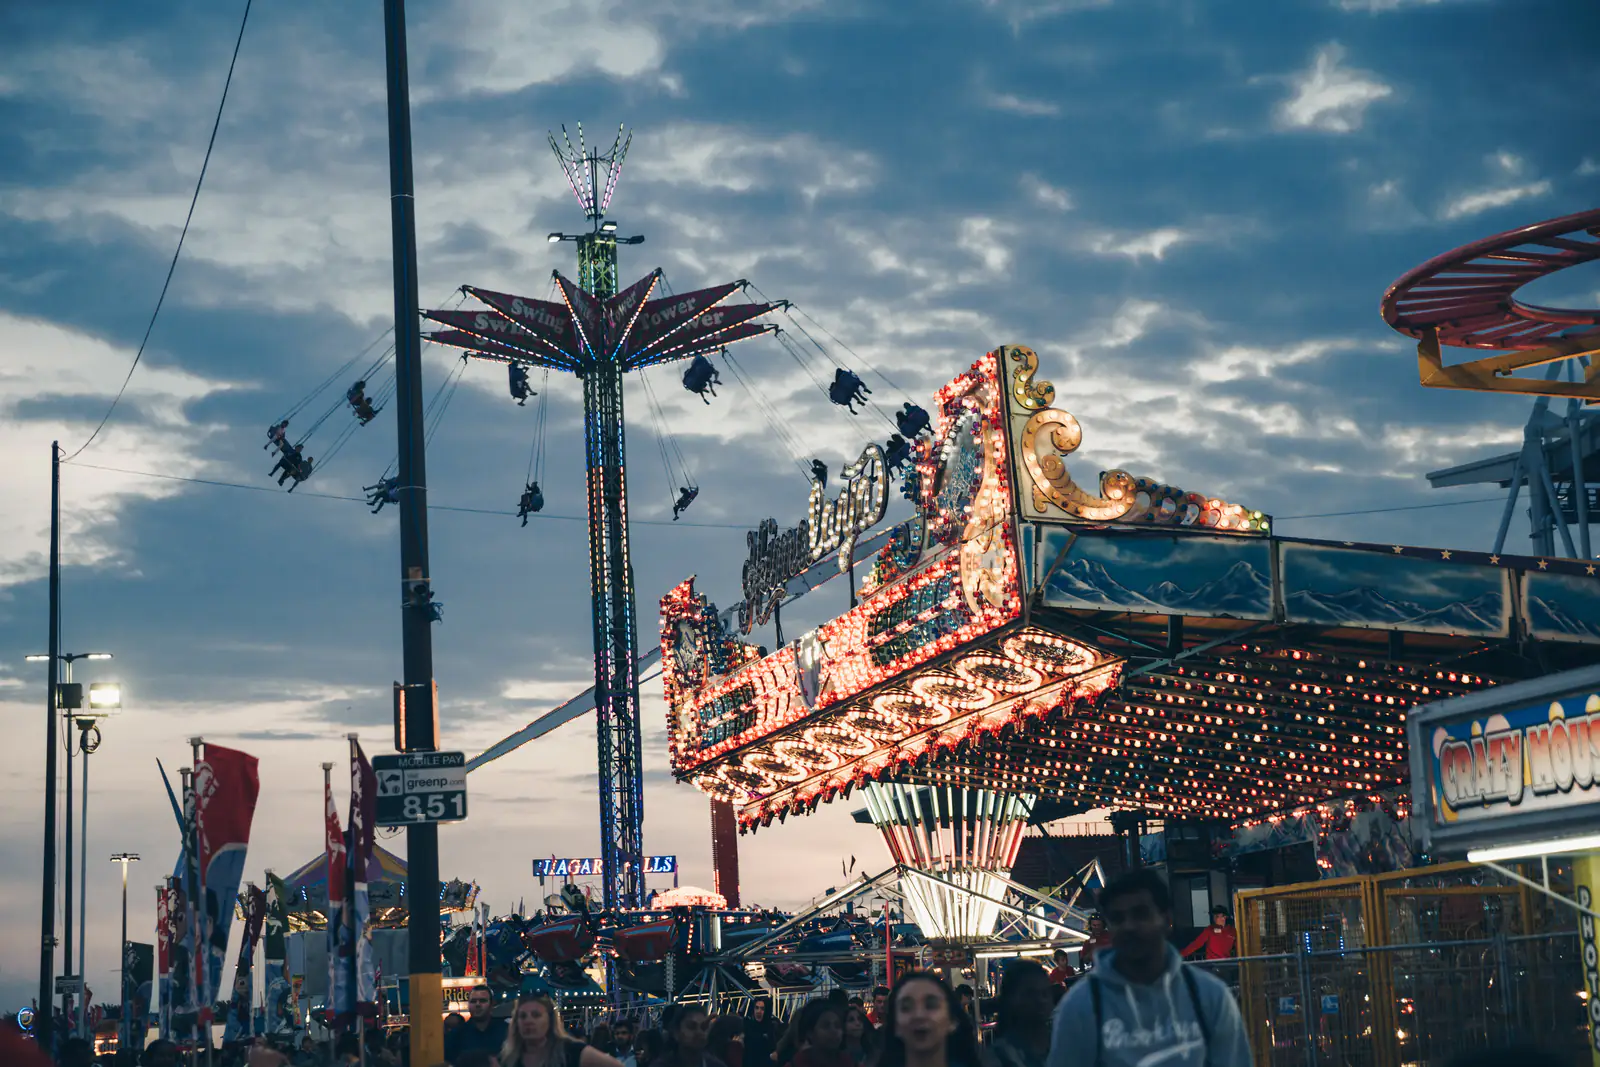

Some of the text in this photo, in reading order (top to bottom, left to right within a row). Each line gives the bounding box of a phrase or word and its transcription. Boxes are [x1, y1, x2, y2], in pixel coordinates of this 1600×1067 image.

[511, 298, 564, 334] Swing
[640, 297, 696, 330] Tower
[398, 755, 462, 768] MOBILE PAY
[1440, 728, 1524, 808] CRAZY
[403, 793, 463, 819] 851
[536, 859, 603, 875] NIAGAR
